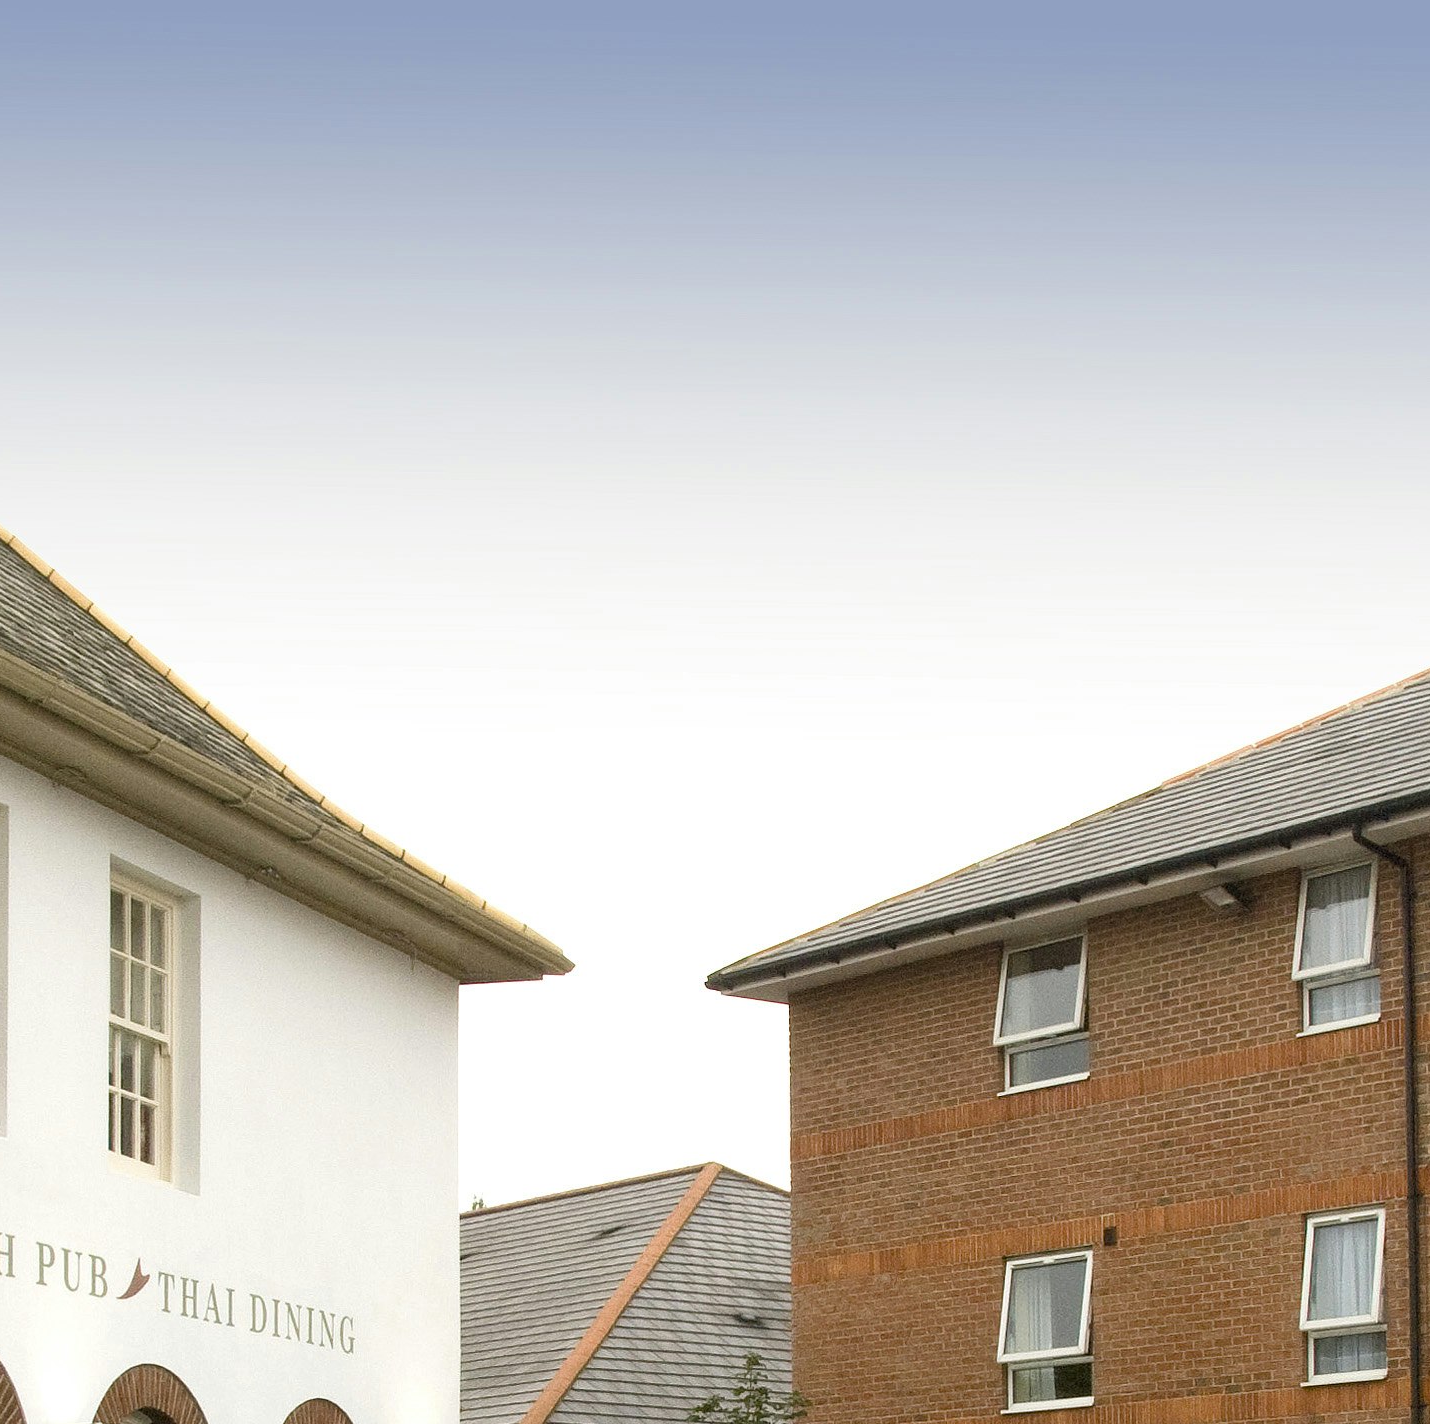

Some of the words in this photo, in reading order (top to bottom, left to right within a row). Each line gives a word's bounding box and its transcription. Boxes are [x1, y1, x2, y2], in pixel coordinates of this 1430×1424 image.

[36, 1241, 109, 1300] PUB
[158, 1271, 236, 1328] THAI
[250, 1293, 357, 1355] DINING
